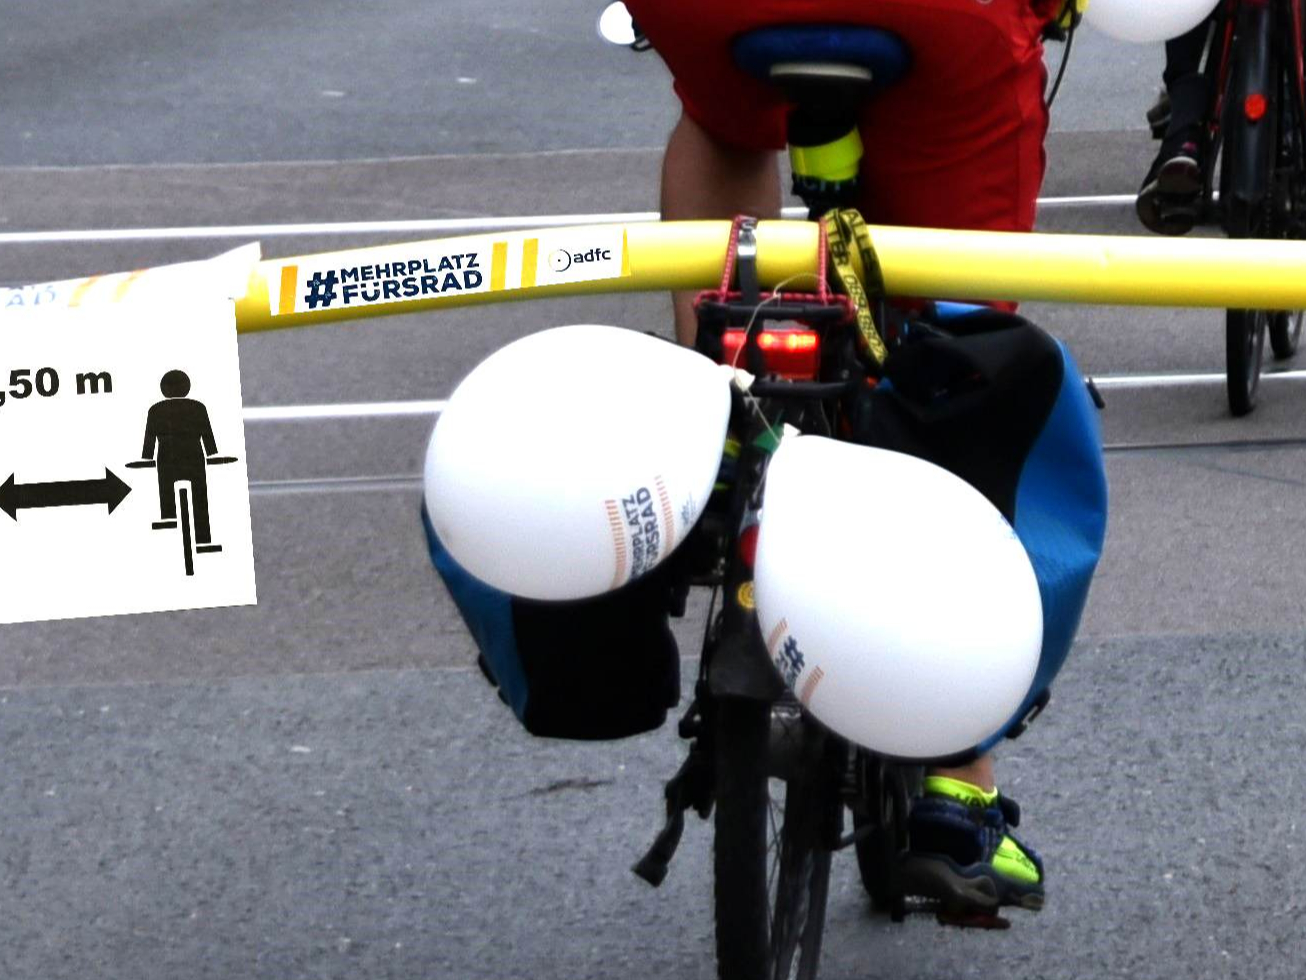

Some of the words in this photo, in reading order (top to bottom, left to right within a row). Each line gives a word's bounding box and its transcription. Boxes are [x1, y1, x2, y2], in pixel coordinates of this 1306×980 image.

[573, 247, 612, 265] adfc
[344, 270, 483, 304] FÜRSRAD
[76, 371, 113, 395] m
